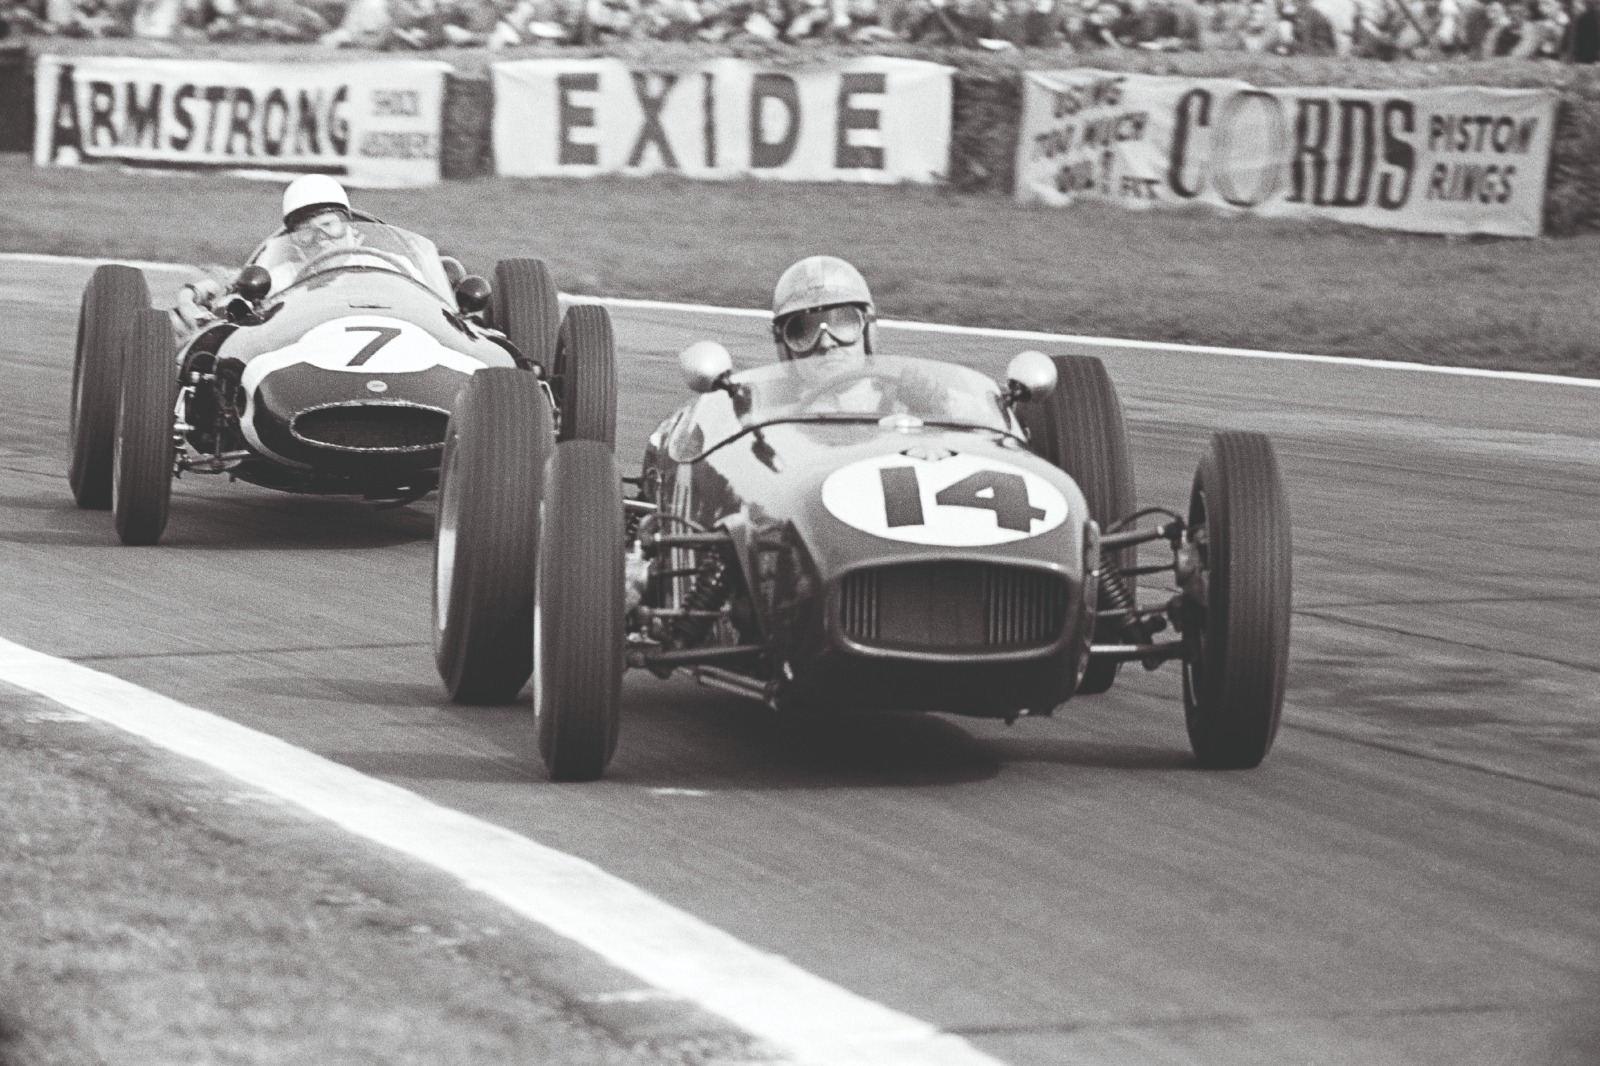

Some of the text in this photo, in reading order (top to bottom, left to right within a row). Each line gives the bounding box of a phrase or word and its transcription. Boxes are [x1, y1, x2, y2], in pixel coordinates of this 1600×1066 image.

[51, 65, 350, 163] ARMSTRONG
[556, 70, 888, 171] EXIDE
[1427, 114, 1540, 154] PISTON
[1167, 87, 1416, 211] CORDS
[1425, 162, 1517, 204] RINGS
[344, 326, 402, 367] 7
[879, 466, 1047, 534] 14
